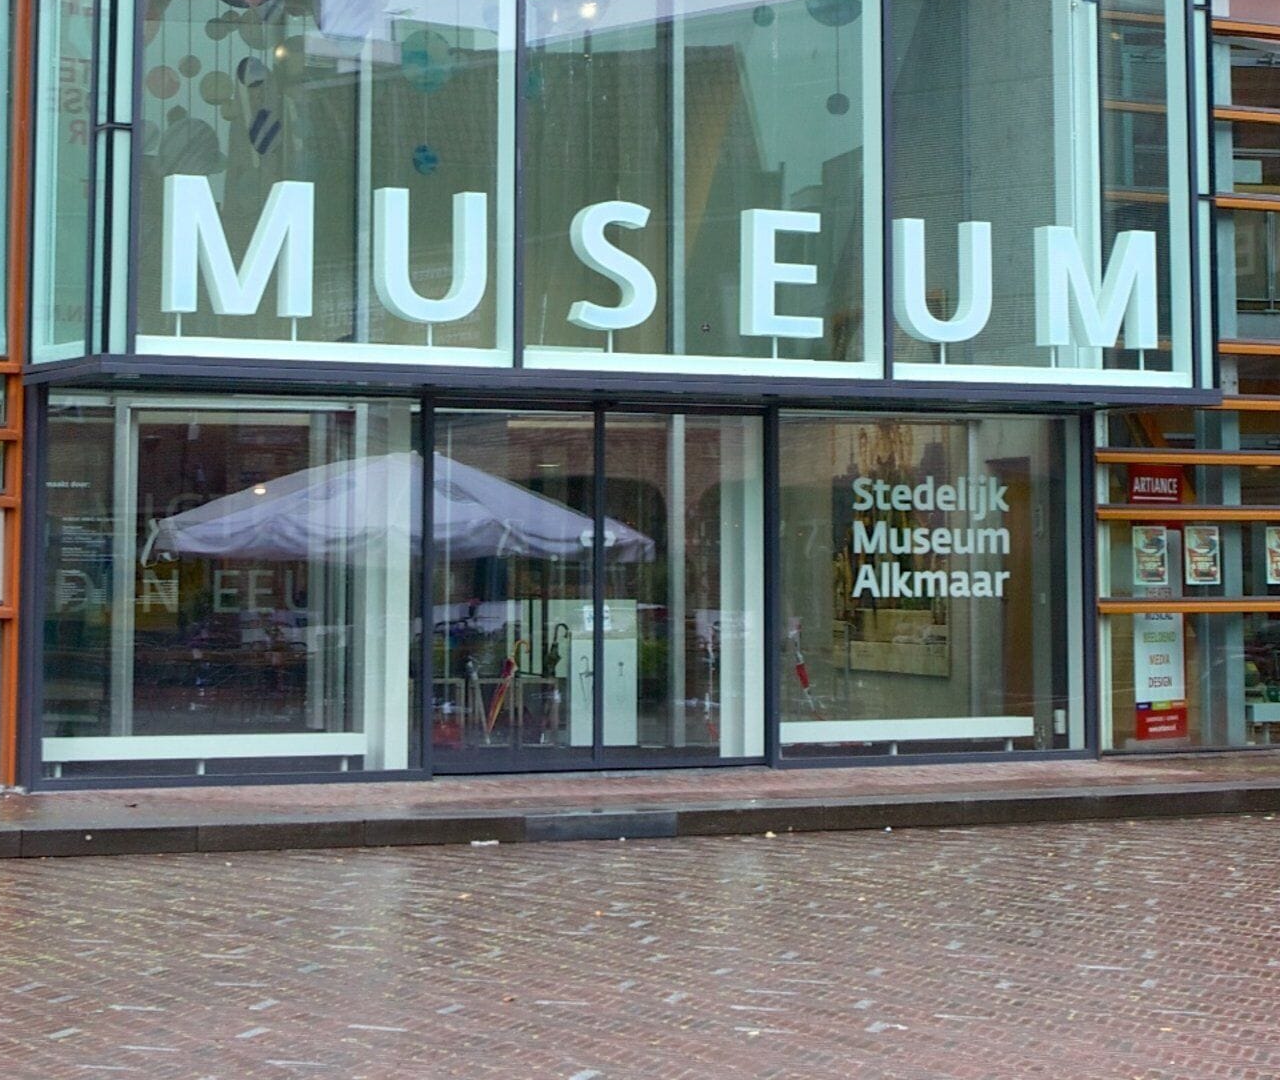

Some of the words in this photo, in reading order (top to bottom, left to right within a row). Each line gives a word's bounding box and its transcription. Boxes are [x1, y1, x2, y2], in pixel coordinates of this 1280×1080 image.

[160, 173, 1158, 350] MUSEUM
[852, 475, 1010, 520] Stedelijk
[1133, 476, 1179, 494] ARTIANCE
[853, 520, 1010, 555] Museum
[851, 561, 1010, 598] Alkmaar
